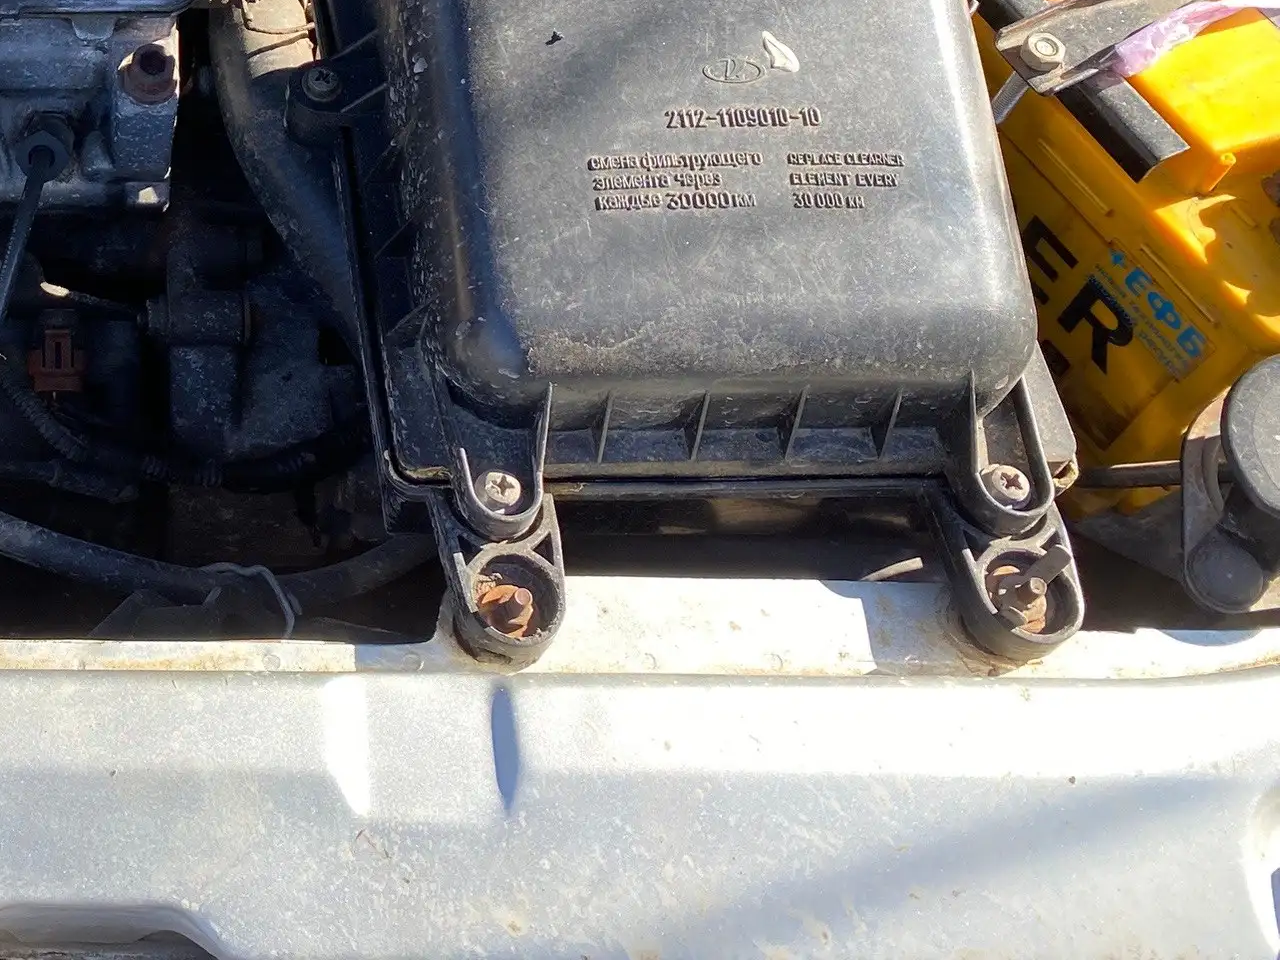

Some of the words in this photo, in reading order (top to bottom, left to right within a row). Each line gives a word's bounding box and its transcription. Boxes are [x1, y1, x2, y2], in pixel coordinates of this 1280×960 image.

[664, 106, 822, 129] 2112-1109010-10
[640, 152, 764, 171] фильтрующего
[787, 152, 842, 166] REPLACE
[592, 173, 671, 191] элемента
[674, 171, 723, 190] через
[790, 173, 851, 186] ELEMENT
[855, 173, 900, 187] EVERY
